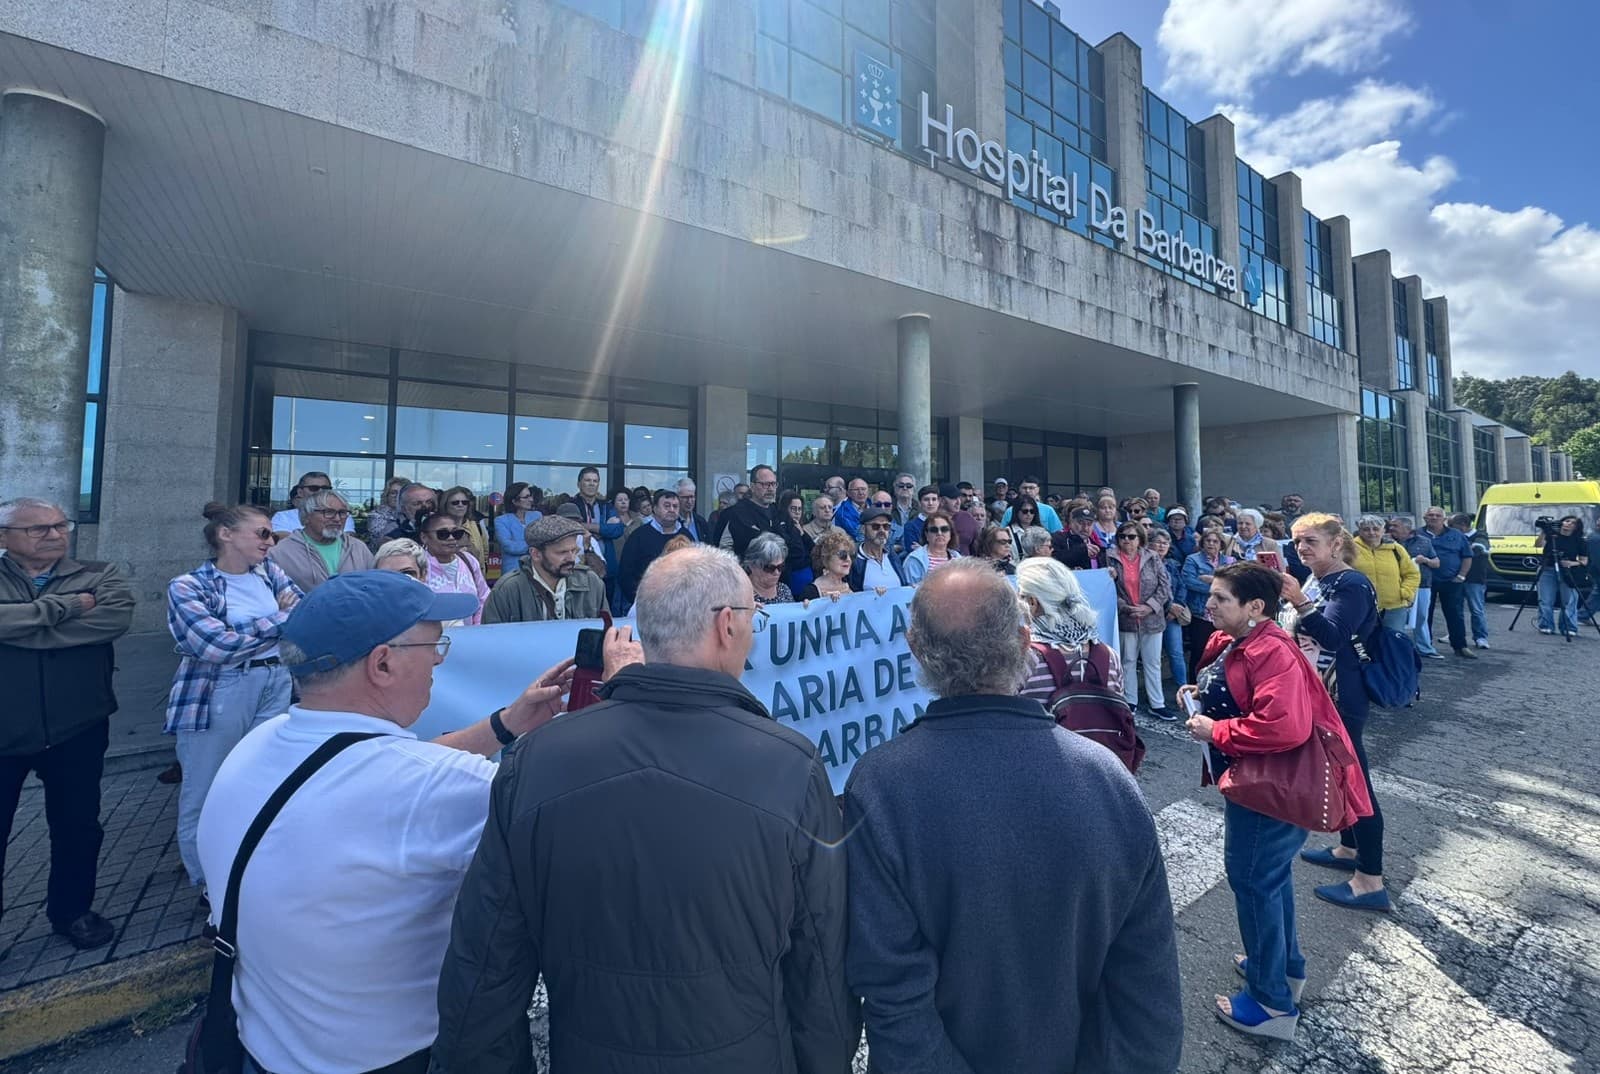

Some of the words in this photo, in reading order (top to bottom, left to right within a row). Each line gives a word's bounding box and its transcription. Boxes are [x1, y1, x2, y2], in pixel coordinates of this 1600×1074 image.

[920, 90, 1078, 218] Hospital
[1090, 182, 1129, 242] Da
[1137, 207, 1238, 293] Barbanza
[769, 609, 881, 667] UNHA
[888, 602, 912, 642] A
[771, 665, 865, 722] ARIA
[873, 652, 916, 698] DE
[818, 702, 925, 768] ARBA
